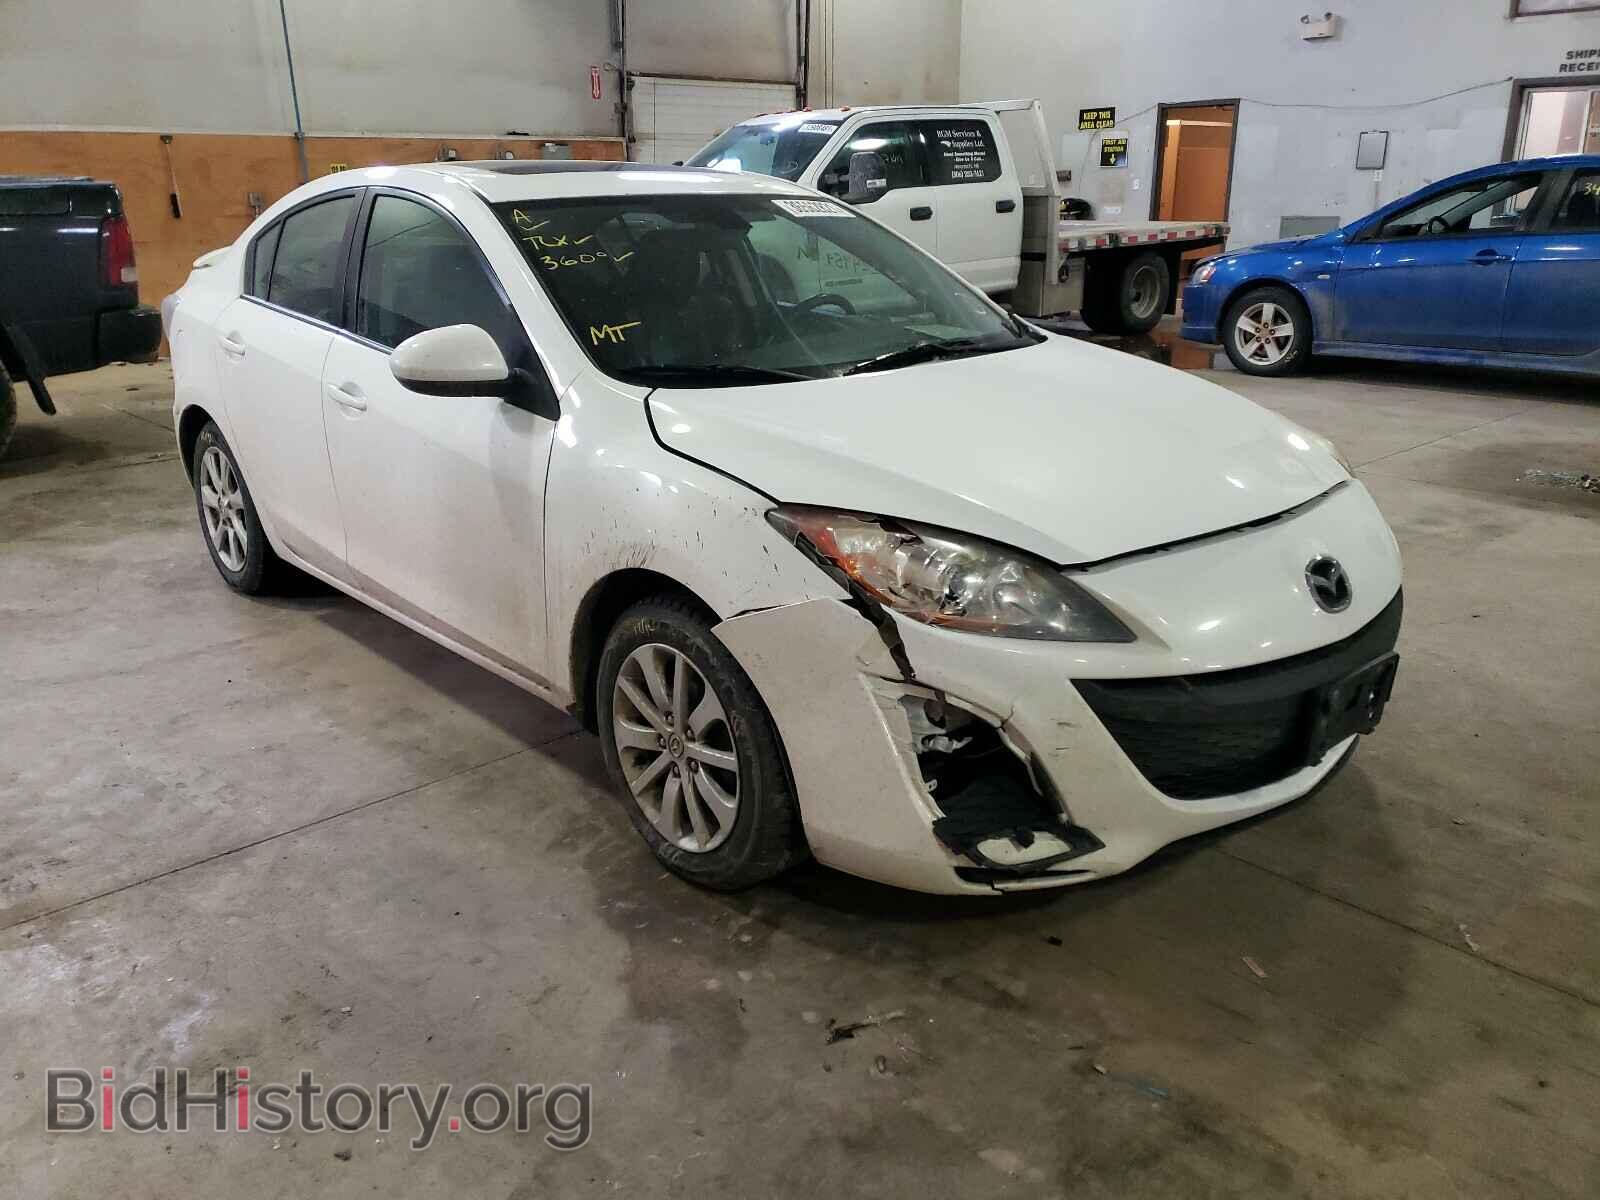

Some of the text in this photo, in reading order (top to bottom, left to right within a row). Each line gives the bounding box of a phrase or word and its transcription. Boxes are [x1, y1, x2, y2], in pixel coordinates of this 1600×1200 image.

[1083, 111, 1111, 120] KEEP THIS
[1080, 120, 1114, 129] AREA CLEAR
[512, 208, 533, 224] A
[590, 321, 641, 346] MT
